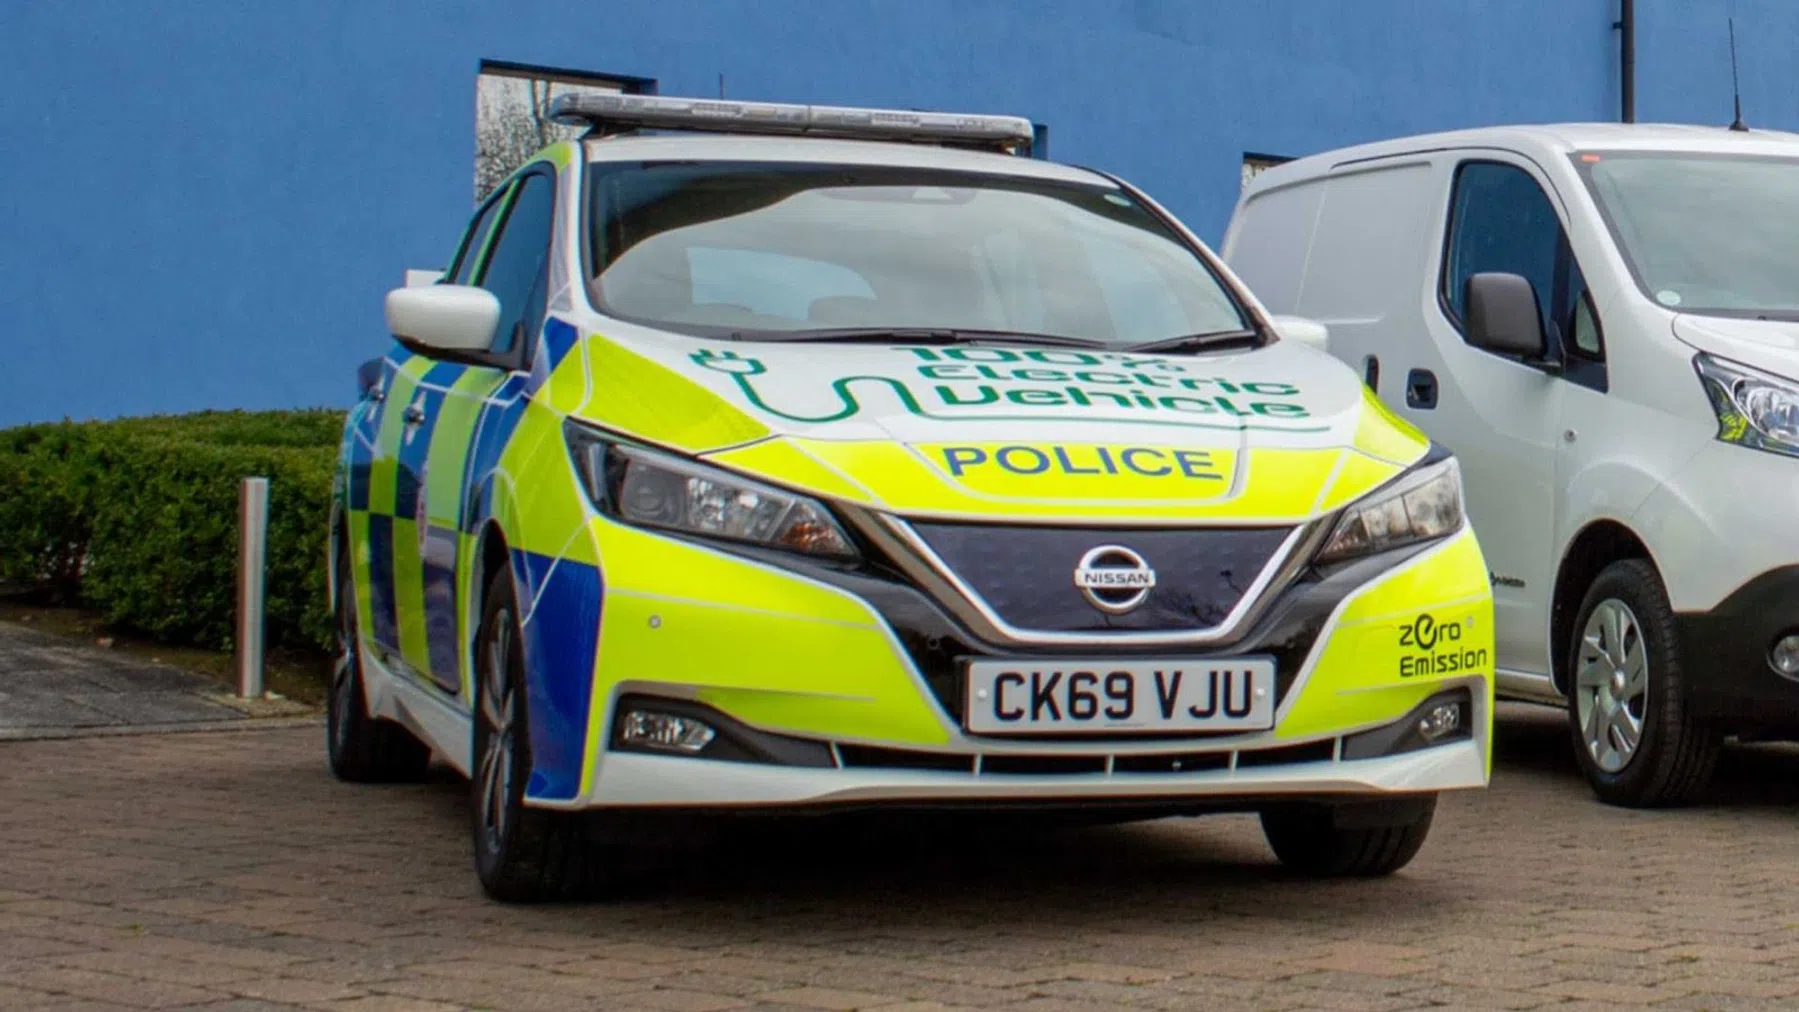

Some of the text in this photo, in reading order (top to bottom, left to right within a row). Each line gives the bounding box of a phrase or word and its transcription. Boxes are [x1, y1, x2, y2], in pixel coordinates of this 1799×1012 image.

[893, 347, 1187, 372] 100%
[917, 364, 1300, 396] Electric
[934, 385, 1311, 418] Vehicle
[942, 446, 1224, 481] POLICE
[1084, 572, 1150, 584] NISSAN
[1398, 613, 1462, 650] zero
[1399, 646, 1487, 677] Emission
[993, 670, 1253, 722] CK69 VJU
